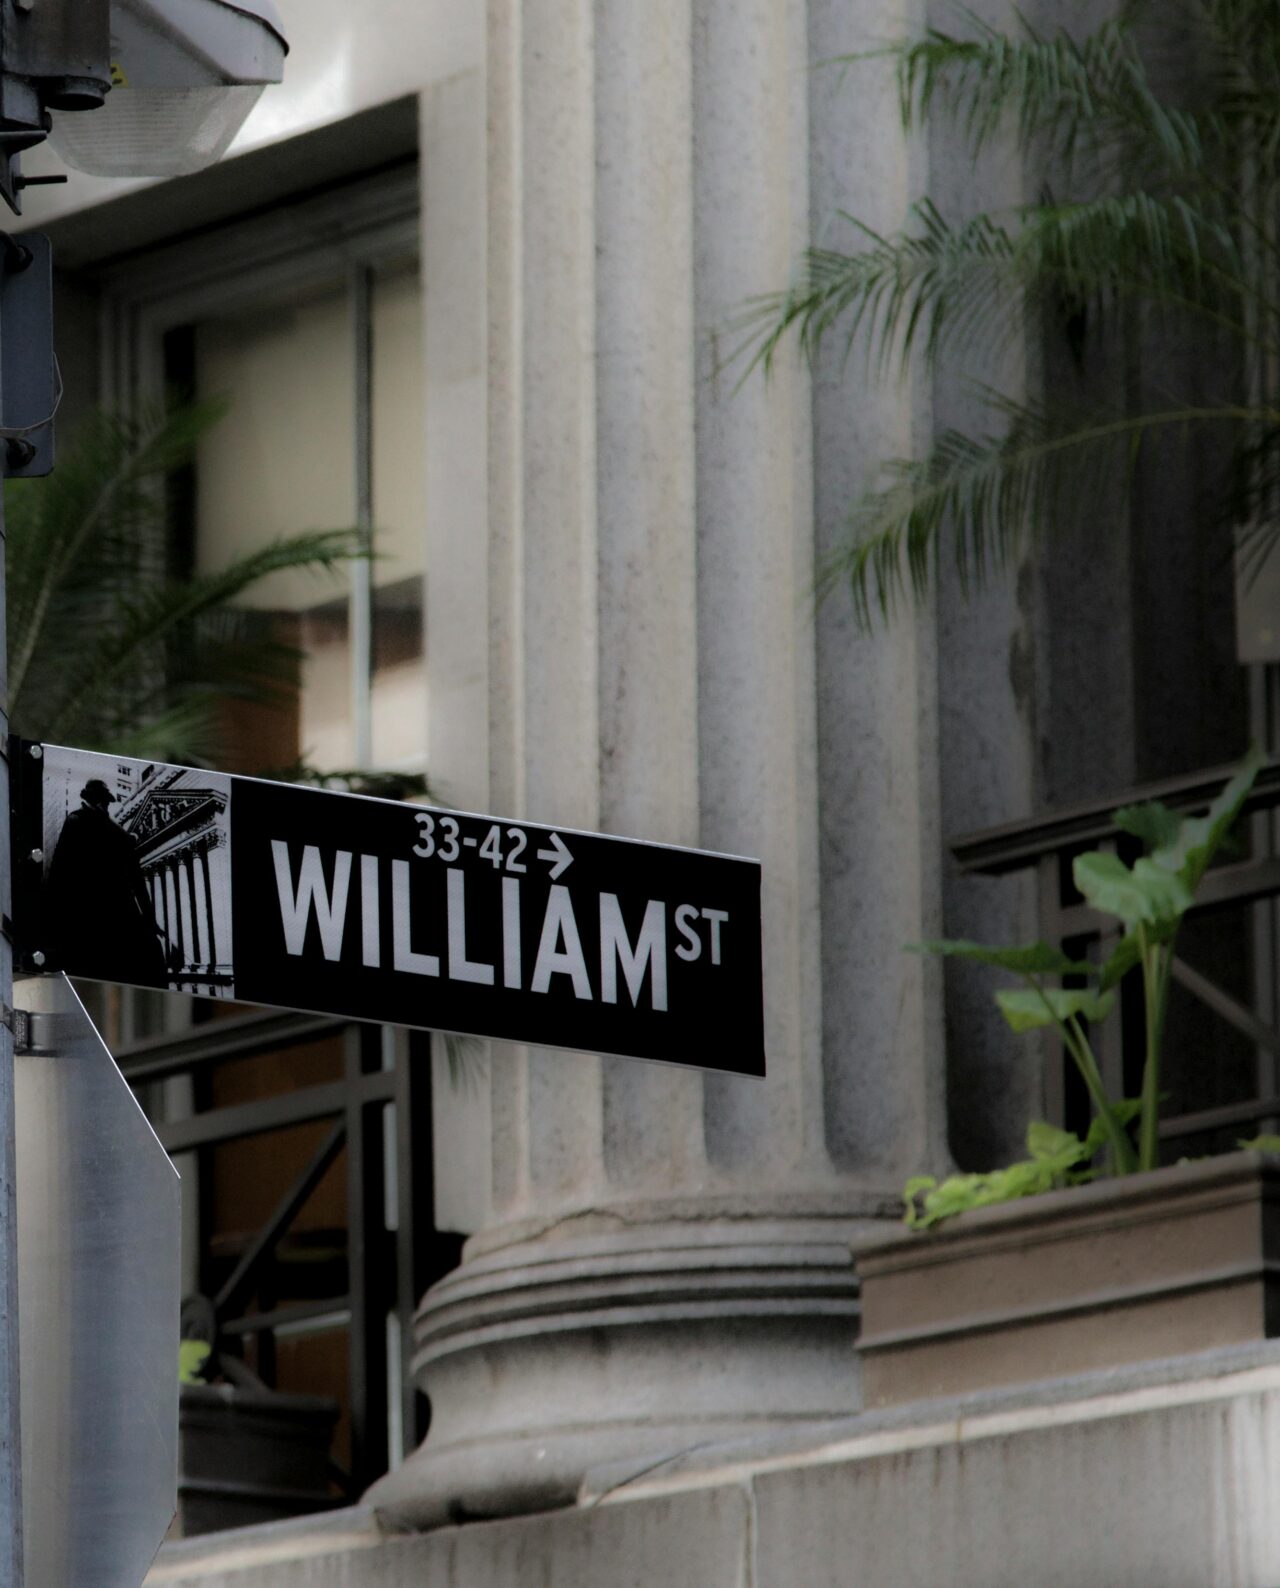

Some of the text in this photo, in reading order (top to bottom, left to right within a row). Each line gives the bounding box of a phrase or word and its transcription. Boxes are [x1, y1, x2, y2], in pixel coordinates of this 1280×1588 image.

[412, 812, 528, 873] 33-42
[270, 839, 729, 1013] WILLIAM ST
